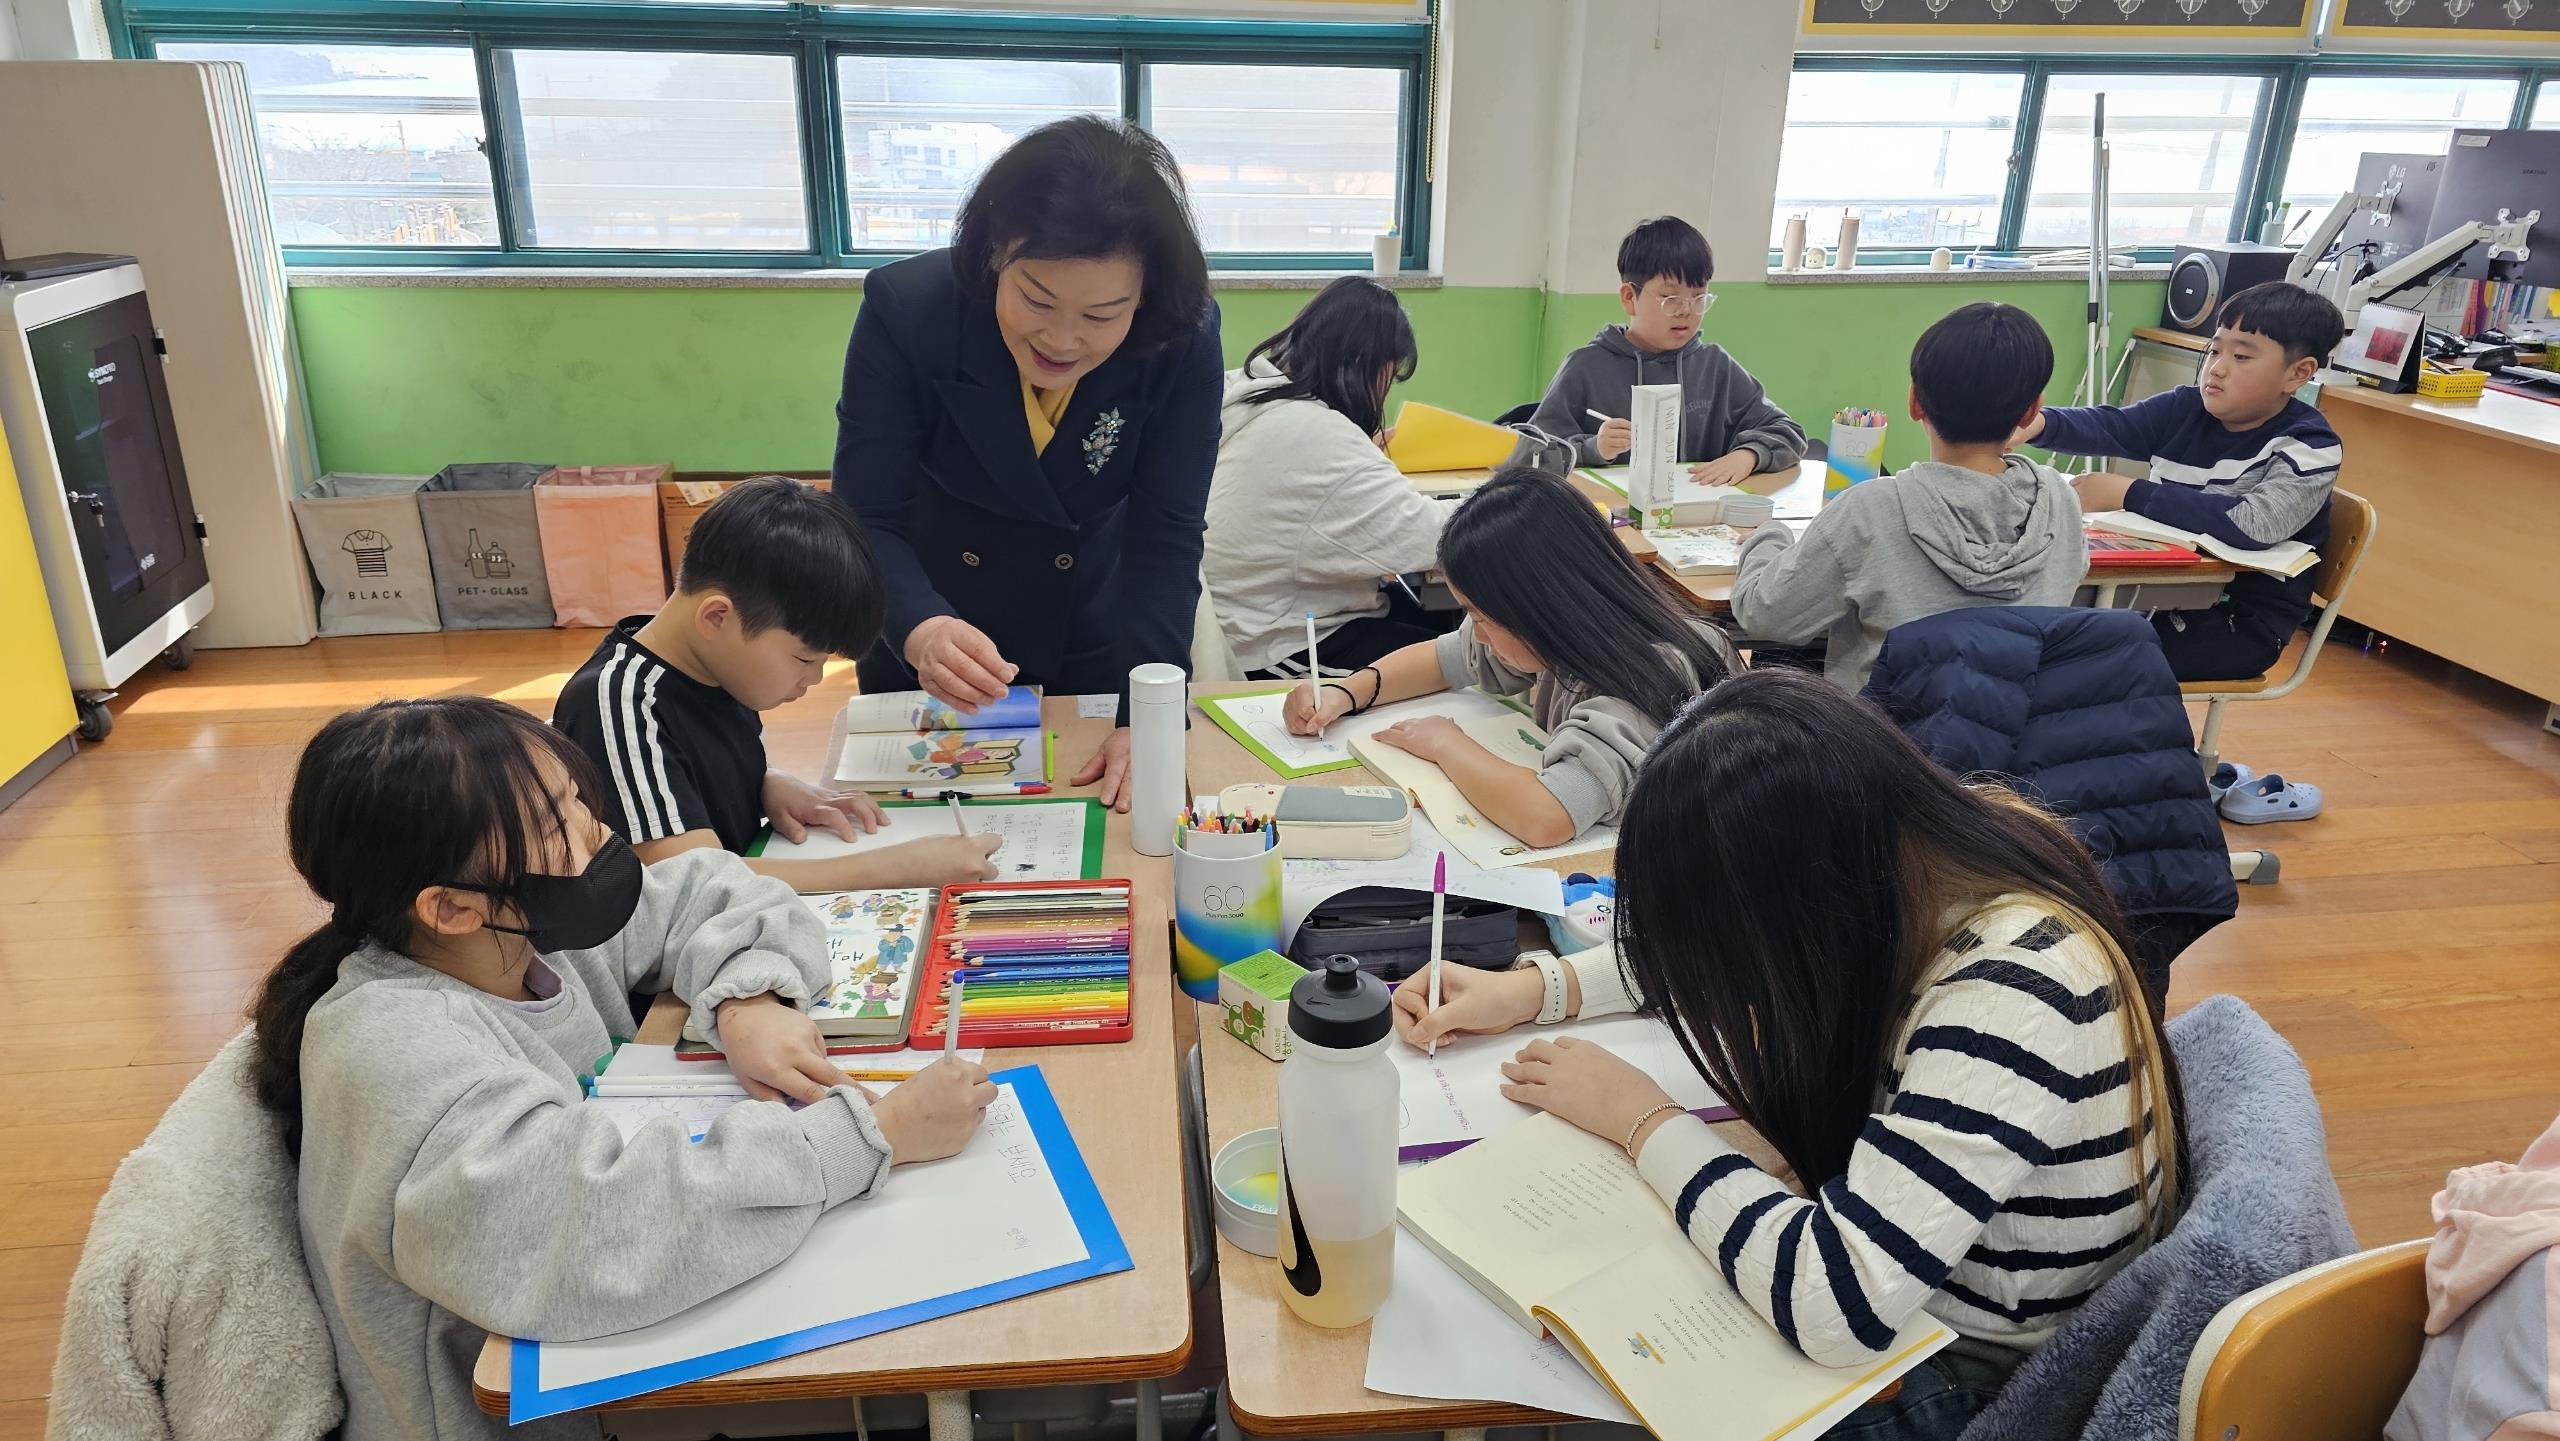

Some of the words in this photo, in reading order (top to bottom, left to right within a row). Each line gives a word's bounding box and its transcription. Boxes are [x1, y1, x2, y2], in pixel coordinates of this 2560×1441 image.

[348, 590, 402, 600] BLACK
[458, 587, 479, 596] PET
[490, 587, 529, 596] GLASS
[1203, 885, 1244, 911] 60
